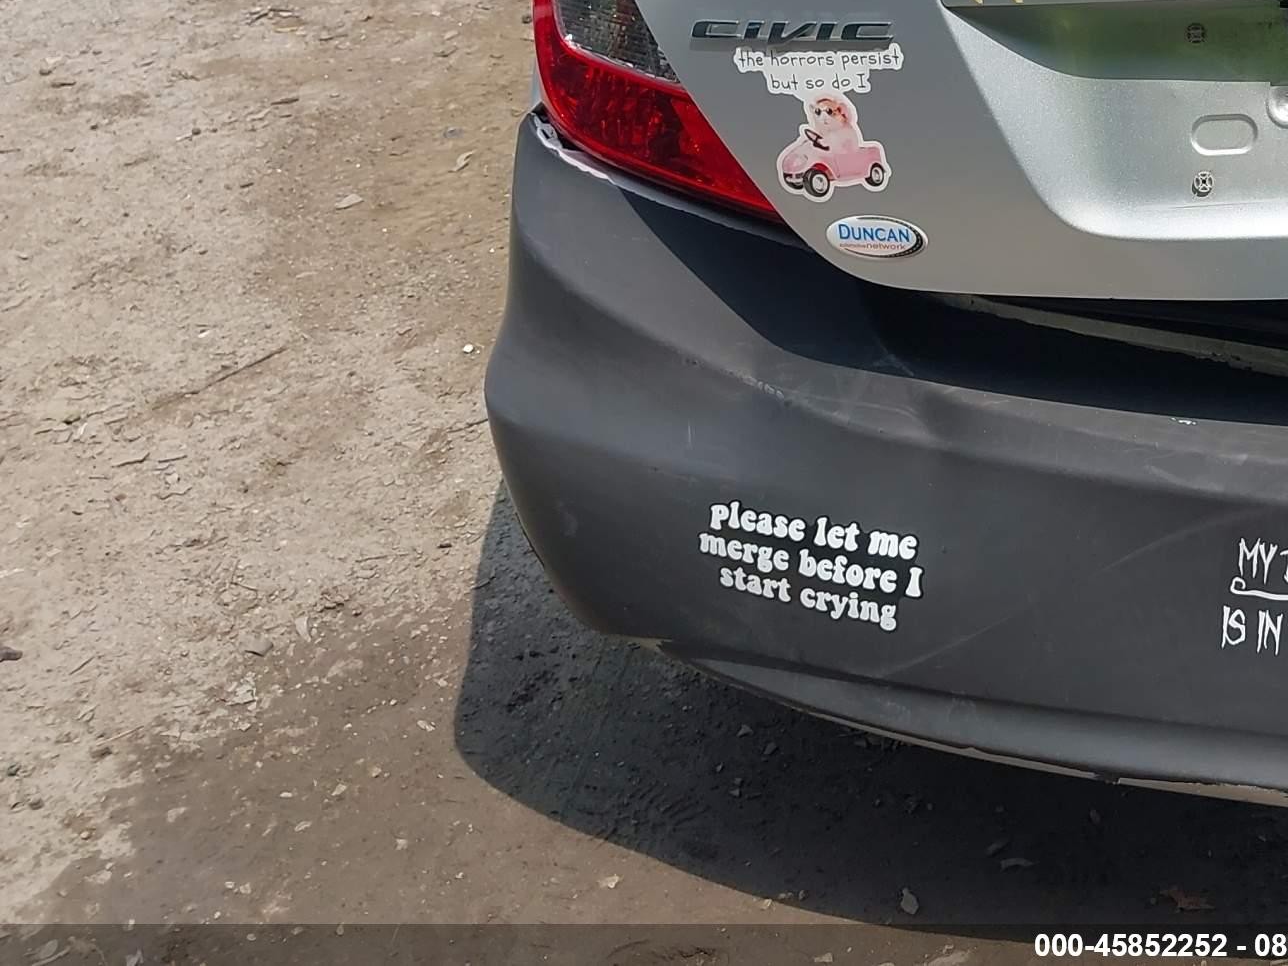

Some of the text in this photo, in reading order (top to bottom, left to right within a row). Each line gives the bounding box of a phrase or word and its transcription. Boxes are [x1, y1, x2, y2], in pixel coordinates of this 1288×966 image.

[691, 20, 895, 45] CIVIC
[738, 47, 901, 71] the horrors persist
[770, 72, 867, 89] but so do I
[838, 223, 911, 243] DUNCAN
[814, 516, 860, 552] let
[867, 530, 918, 560] me
[699, 533, 923, 597] merge before I
[1238, 537, 1279, 585] MY
[719, 566, 898, 631] start crying
[1221, 604, 1247, 648] IS
[1256, 609, 1284, 656] IN
